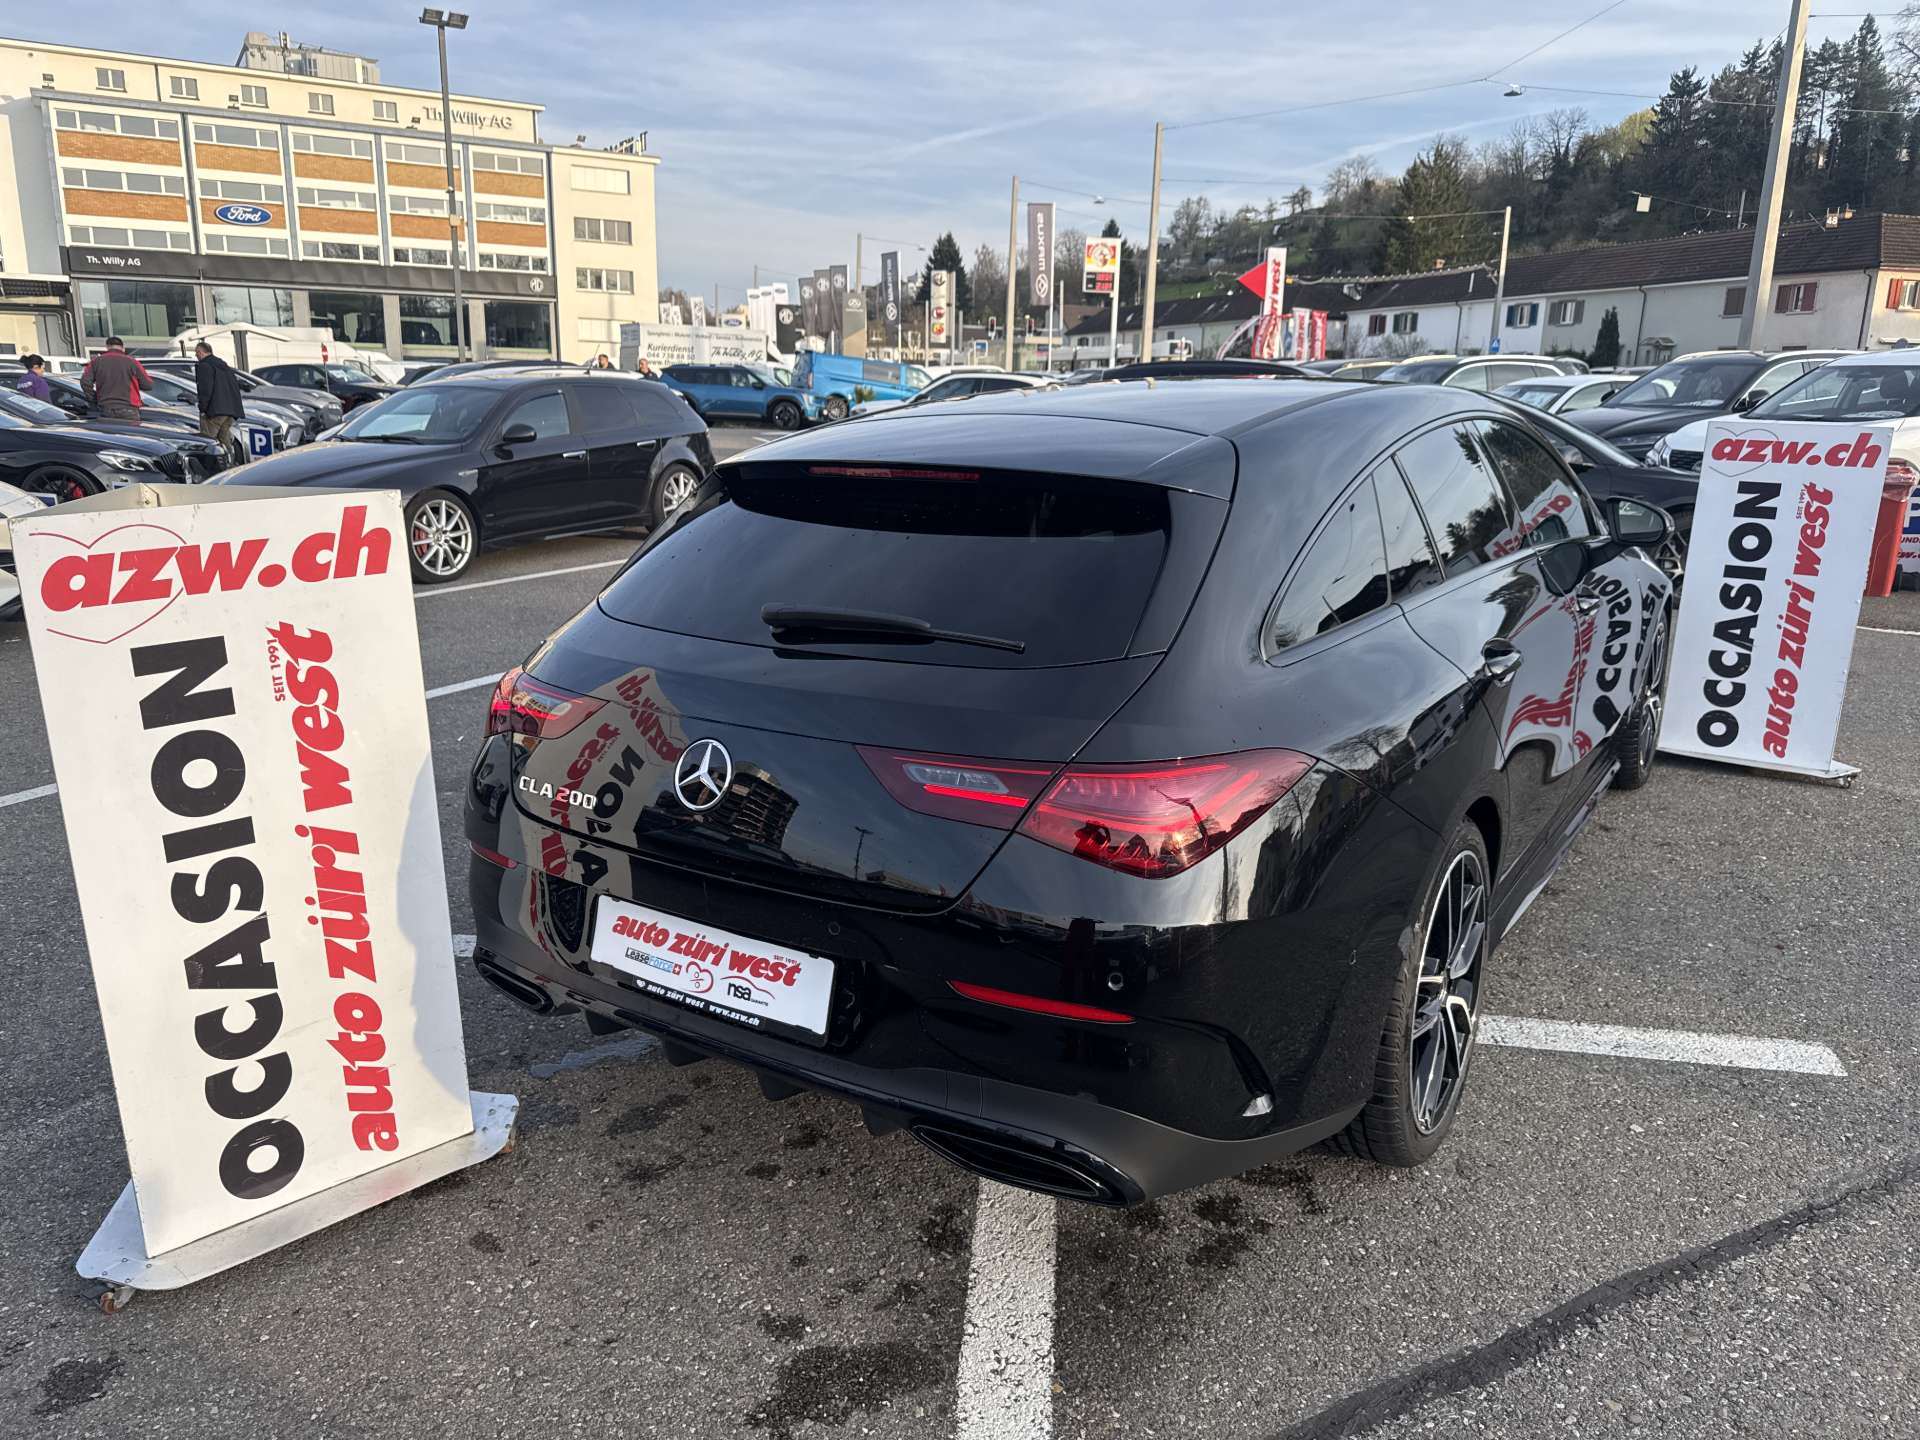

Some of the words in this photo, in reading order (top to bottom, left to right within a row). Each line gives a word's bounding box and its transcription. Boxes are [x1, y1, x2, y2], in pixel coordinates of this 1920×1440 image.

[451, 109, 486, 130] Willy
[489, 115, 513, 130] AG
[226, 206, 262, 223] Ford
[102, 256, 125, 267] Willy
[127, 258, 141, 266] AG
[254, 433, 267, 452] P
[1711, 432, 1882, 469] azw.ch
[1793, 481, 1834, 577] west
[40, 505, 392, 613] azw.ch
[1696, 480, 1782, 749] OCCASION
[1776, 578, 1816, 671] züri
[266, 639, 281, 670] 1991
[264, 620, 353, 813] west
[272, 675, 286, 702] SEIT
[1762, 668, 1800, 760] auto
[519, 775, 553, 799] CLA
[556, 786, 597, 810] 200
[130, 635, 305, 1200] OCCASION
[293, 824, 377, 984] züri
[612, 915, 671, 948] auto
[667, 932, 730, 966] züri
[728, 950, 802, 987] west
[647, 984, 665, 995] auto
[666, 990, 684, 1001] züri
[685, 996, 705, 1009] west
[709, 1004, 760, 1027] www.azw.ch
[727, 982, 752, 1002] nsa
[326, 992, 400, 1153] auto
